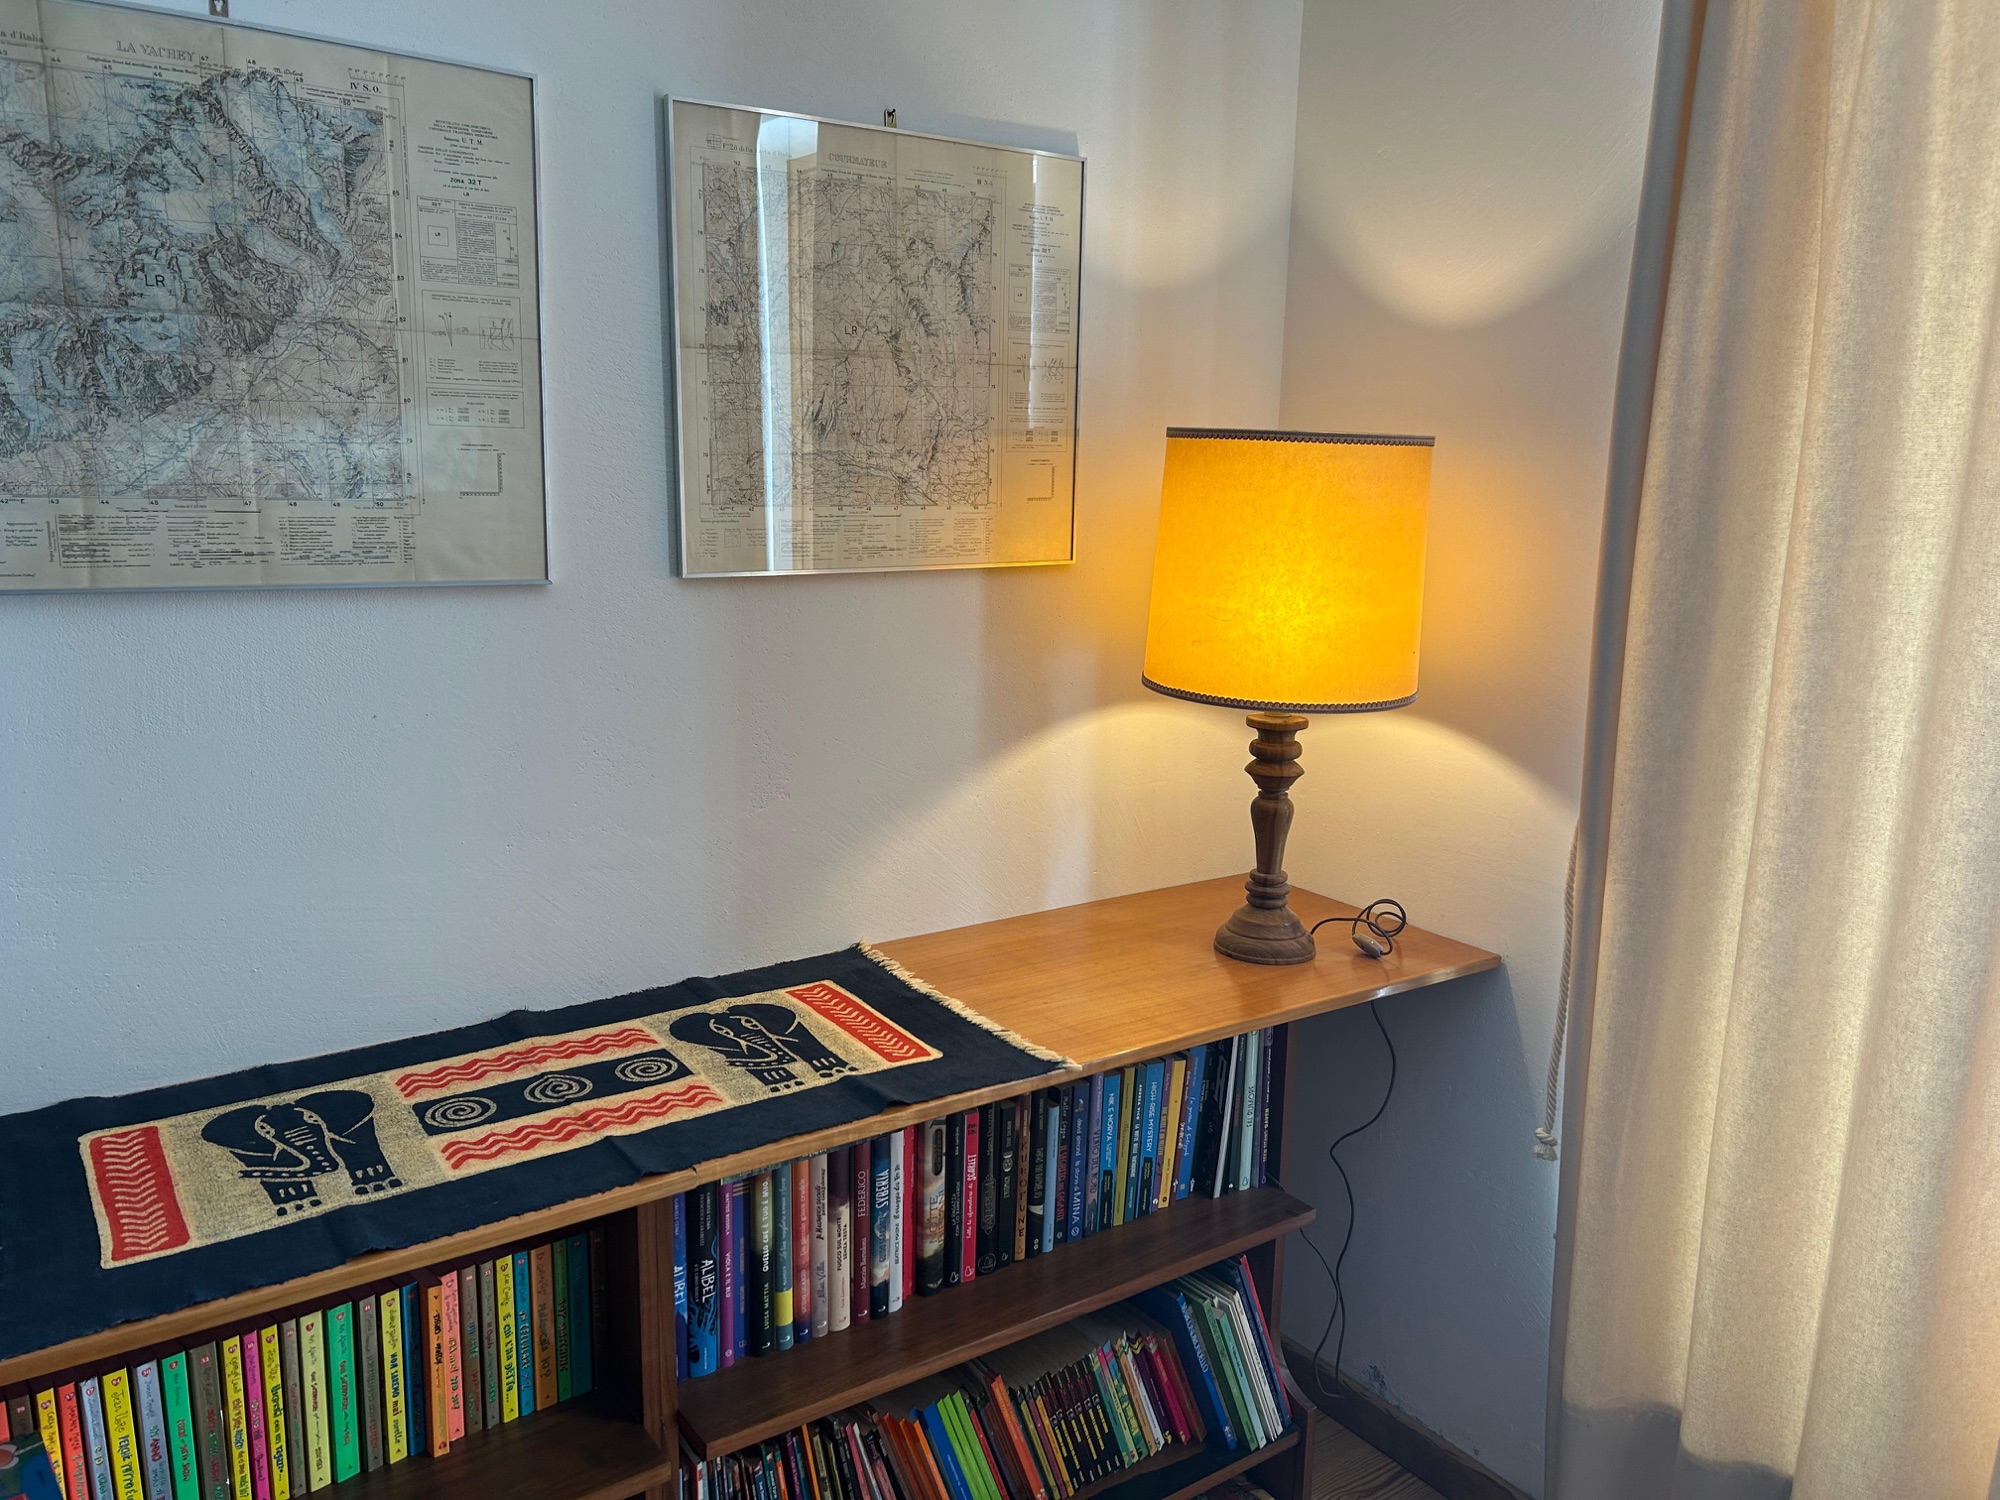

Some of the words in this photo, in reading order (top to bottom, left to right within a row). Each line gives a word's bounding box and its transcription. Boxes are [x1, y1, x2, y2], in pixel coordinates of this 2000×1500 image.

[116, 40, 137, 54] LA
[140, 44, 196, 62] VACHEY
[363, 84, 382, 94] S.O.
[828, 152, 888, 169] COURMAYEUR
[144, 274, 165, 287] LR
[844, 325, 858, 335] LR
[1148, 1082, 1158, 1118] HIGH-RISE
[1247, 1086, 1255, 1115] RUMORE
[1106, 1114, 1114, 1142] NORVA
[1146, 1119, 1154, 1152] MYSTERY
[967, 1154, 977, 1181] SCARLET
[857, 1171, 866, 1217] FEDERICO
[876, 1169, 889, 1209] SYBERIA
[1072, 1192, 1081, 1224] MINA
[519, 1323, 530, 1370] CELLULARE
[390, 1371, 400, 1398] SAREMO
[392, 1400, 402, 1416] mai
[150, 1439, 162, 1461] ANNO
